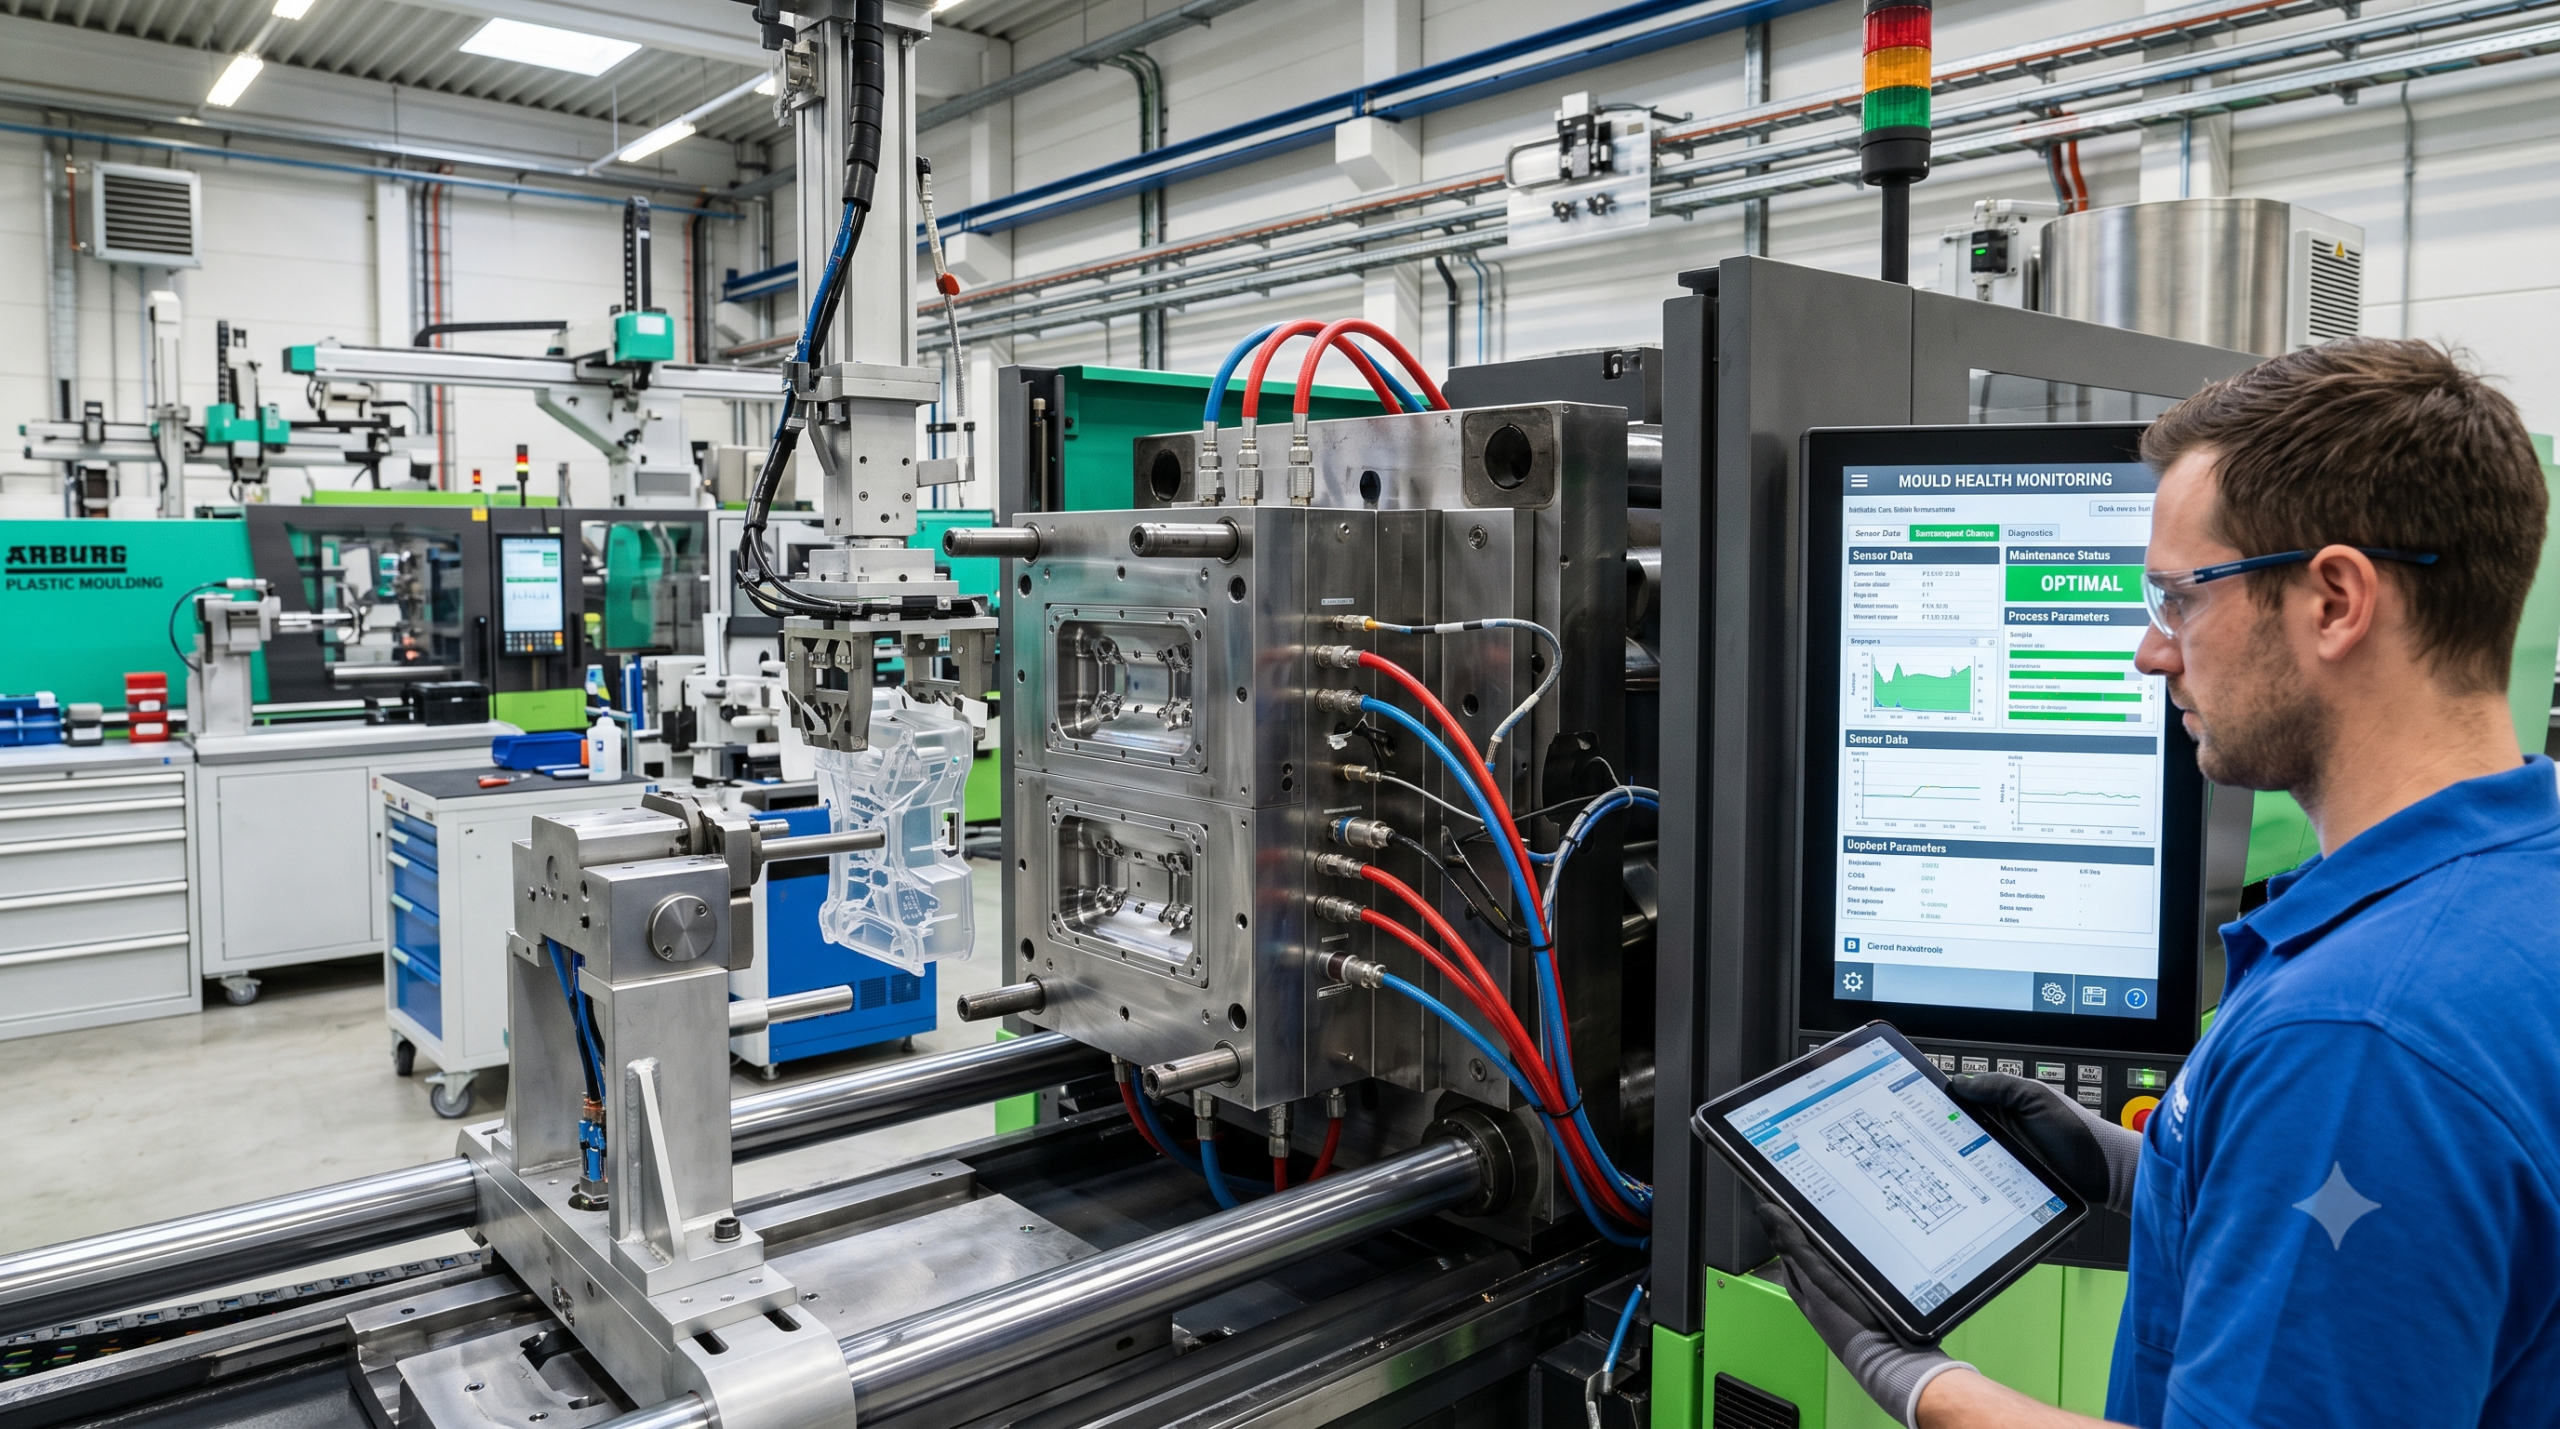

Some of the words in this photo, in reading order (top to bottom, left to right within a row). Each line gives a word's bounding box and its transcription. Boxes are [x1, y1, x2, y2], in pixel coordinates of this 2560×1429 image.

[1899, 474, 1952, 488] MOULD
[1955, 473, 2012, 488] HEALTH
[2016, 472, 2113, 487] MONITORING
[2007, 529, 2053, 539] Diagnostics
[6, 545, 127, 565] ARBURG
[1852, 550, 1888, 561] Sensor
[1890, 550, 1913, 561] Data
[2009, 550, 2075, 561] Maintenance
[2077, 550, 2111, 561] Status
[6, 577, 75, 591] PLASTIC
[79, 576, 164, 590] MOULDING
[2041, 574, 2124, 592] OPTIMAL
[2008, 610, 2049, 622] Process
[2051, 611, 2110, 622] Parameters
[1849, 733, 1884, 745] Sensor
[1885, 734, 1909, 745] Data
[1889, 841, 1947, 853] Parameters
